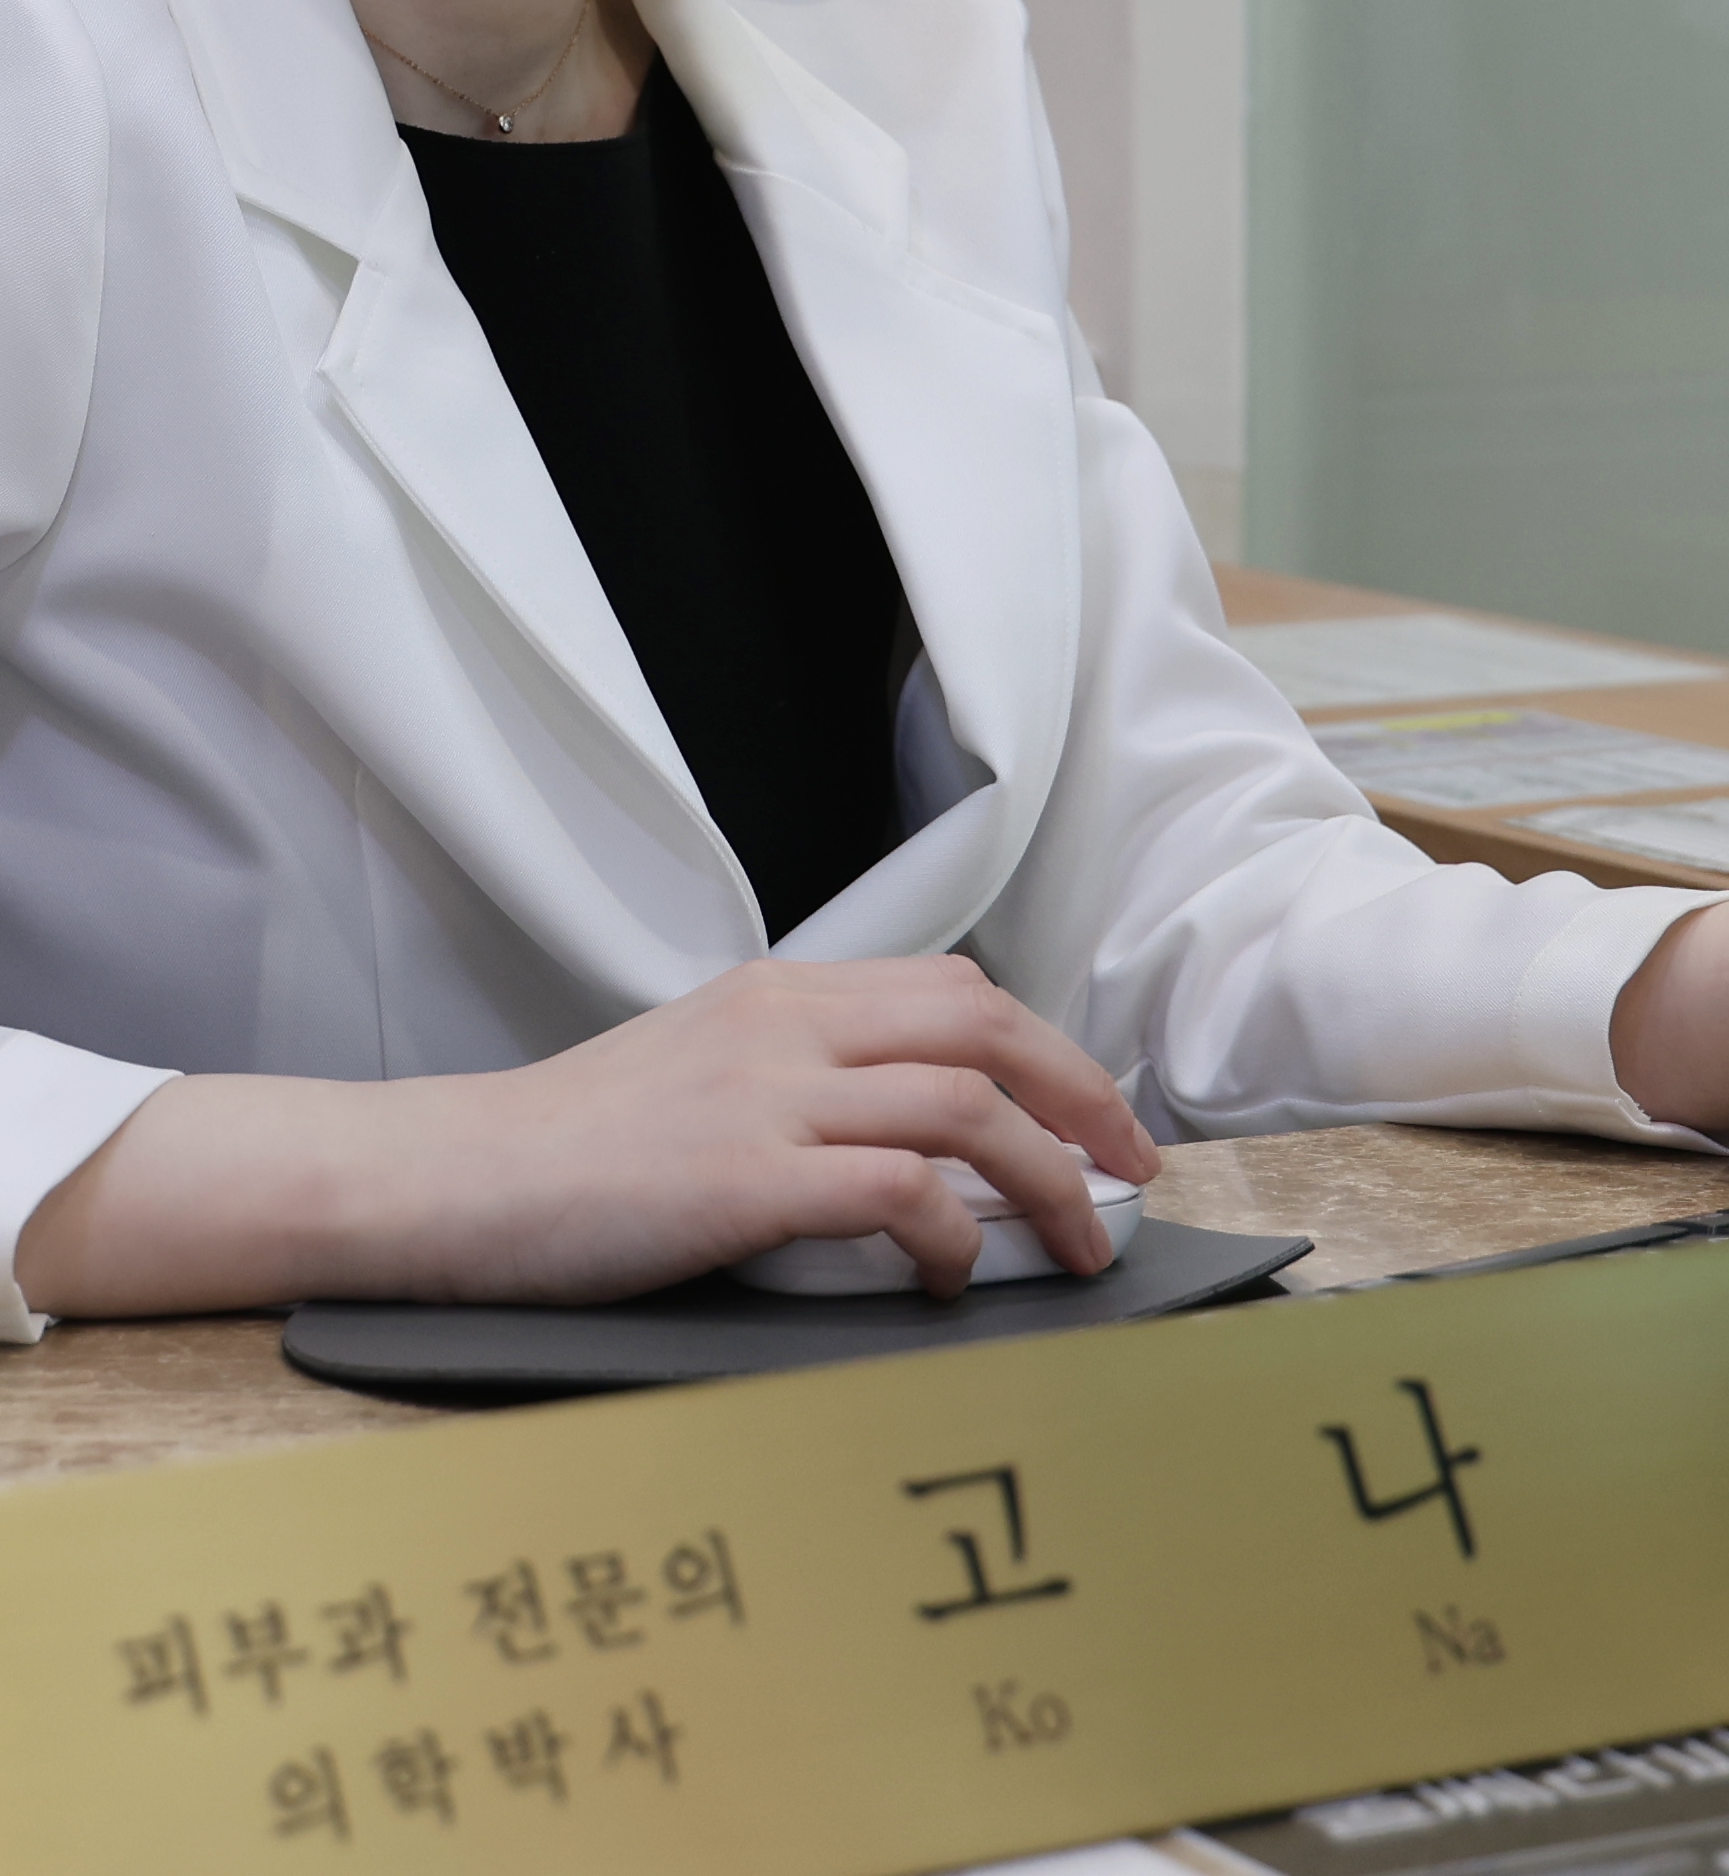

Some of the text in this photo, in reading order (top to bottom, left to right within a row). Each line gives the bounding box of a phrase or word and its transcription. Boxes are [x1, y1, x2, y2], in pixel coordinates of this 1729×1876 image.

[902, 1464, 1073, 1623] 고
[1320, 1378, 1481, 1559] 나
[116, 1528, 747, 1715] 피부과 전문의
[972, 1679, 1072, 1754] Ko
[1412, 1605, 1508, 1674] Na
